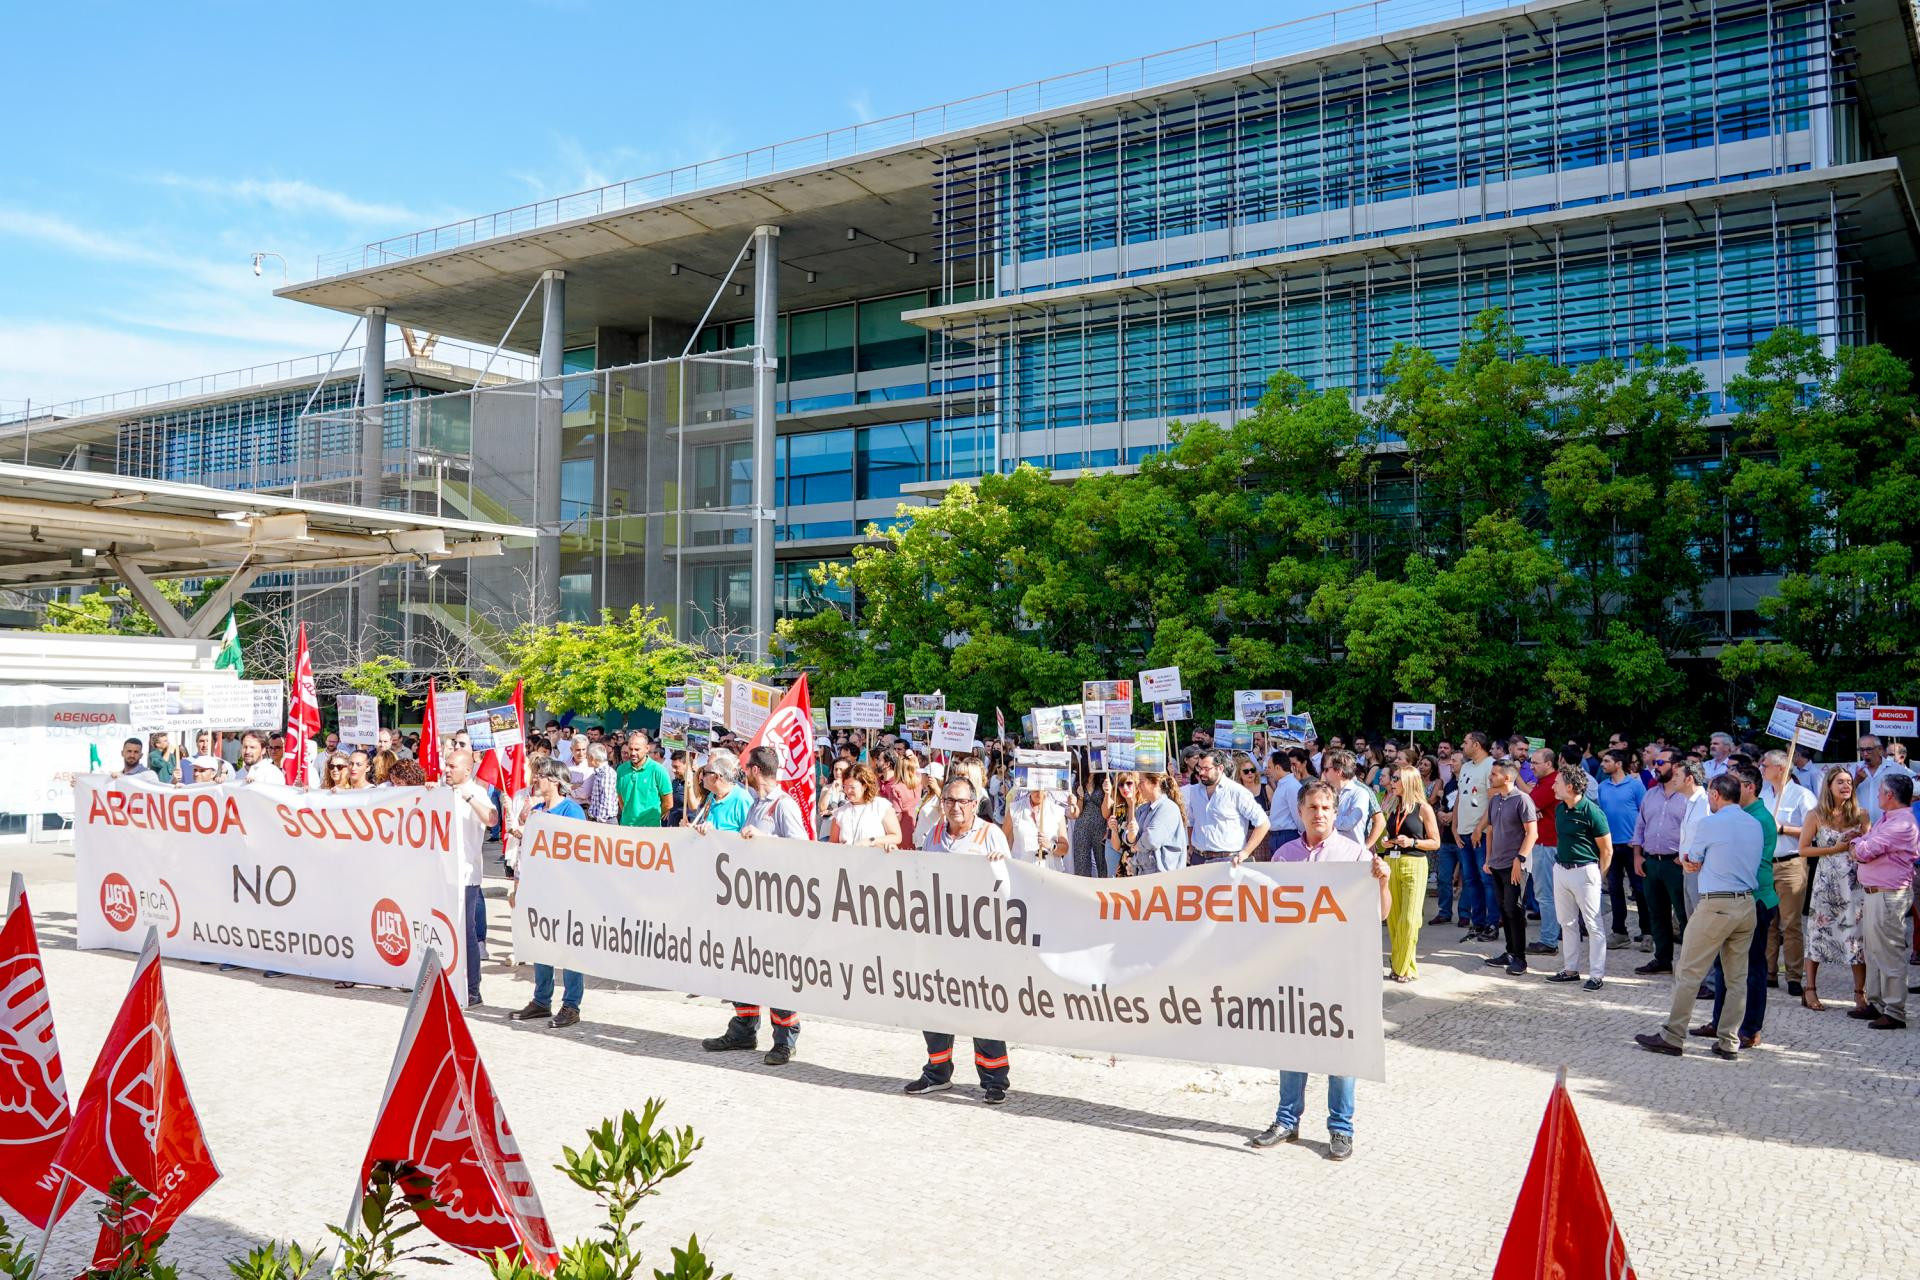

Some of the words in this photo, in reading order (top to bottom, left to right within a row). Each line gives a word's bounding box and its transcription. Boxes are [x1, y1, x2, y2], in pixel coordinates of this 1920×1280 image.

[54, 712, 118, 723] ABENGOA
[137, 724, 165, 732] ABENGO
[89, 789, 247, 835] ABENGOA
[276, 797, 451, 852] SOLUCIÓN
[530, 829, 675, 873] ABENGOA
[105, 884, 130, 906] UGT
[140, 890, 169, 910] FICA
[233, 864, 296, 907] NO
[715, 852, 822, 920] Somos
[832, 867, 1041, 947] Andalucía.
[1096, 884, 1348, 924] INABENSA
[193, 921, 205, 942] A
[206, 923, 243, 947] LOS
[246, 928, 354, 959] DESPIDOS
[377, 910, 402, 937] UGT
[412, 920, 442, 946] FICA
[528, 907, 560, 943] Por
[566, 910, 584, 946] la
[590, 915, 692, 964] viabilidad
[699, 929, 725, 969] de
[731, 936, 833, 993] Abengoa
[839, 962, 853, 1001] y
[863, 956, 885, 995] el
[892, 968, 1009, 1013] sustento
[1018, 975, 1055, 1018] de
[1063, 983, 1149, 1024] miles
[1159, 985, 1202, 1025] de
[1210, 985, 1354, 1040] familias.
